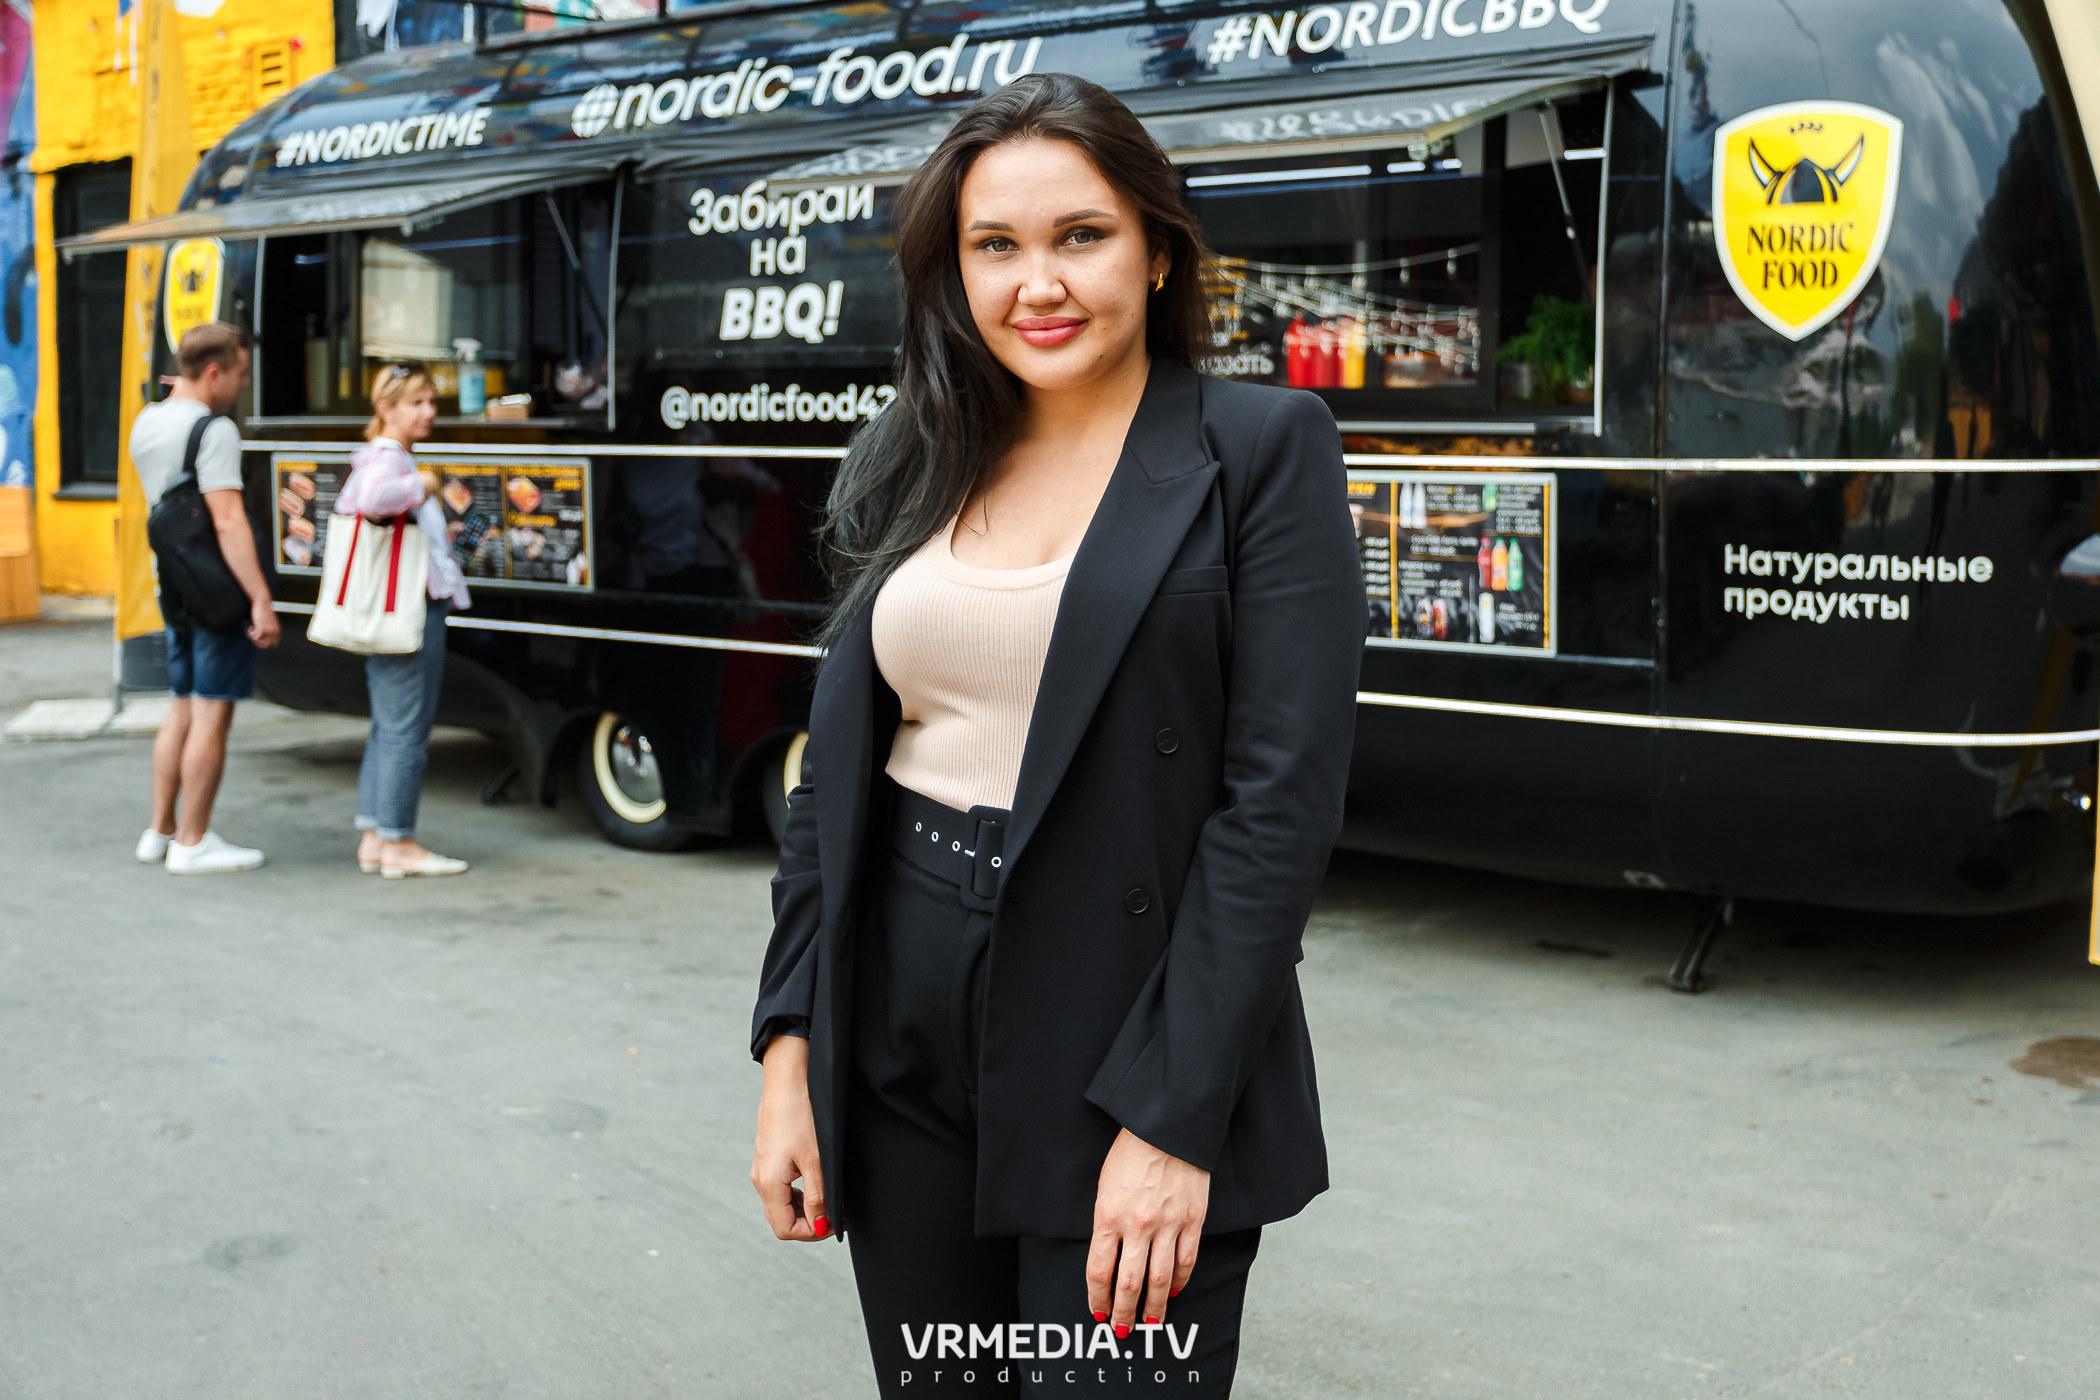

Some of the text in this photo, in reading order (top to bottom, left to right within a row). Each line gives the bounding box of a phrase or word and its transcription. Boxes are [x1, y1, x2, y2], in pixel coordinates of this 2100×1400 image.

[1207, 0, 1605, 64] #NORDICBBQ
[275, 106, 493, 168] #NORDICTIME
[750, 235, 807, 276] на
[1747, 222, 1855, 257] NORDIC
[1761, 260, 1838, 291] FOOD
[719, 280, 844, 343] BBQ!
[1724, 543, 1994, 585] Натуральные
[1724, 586, 1910, 623] продукты
